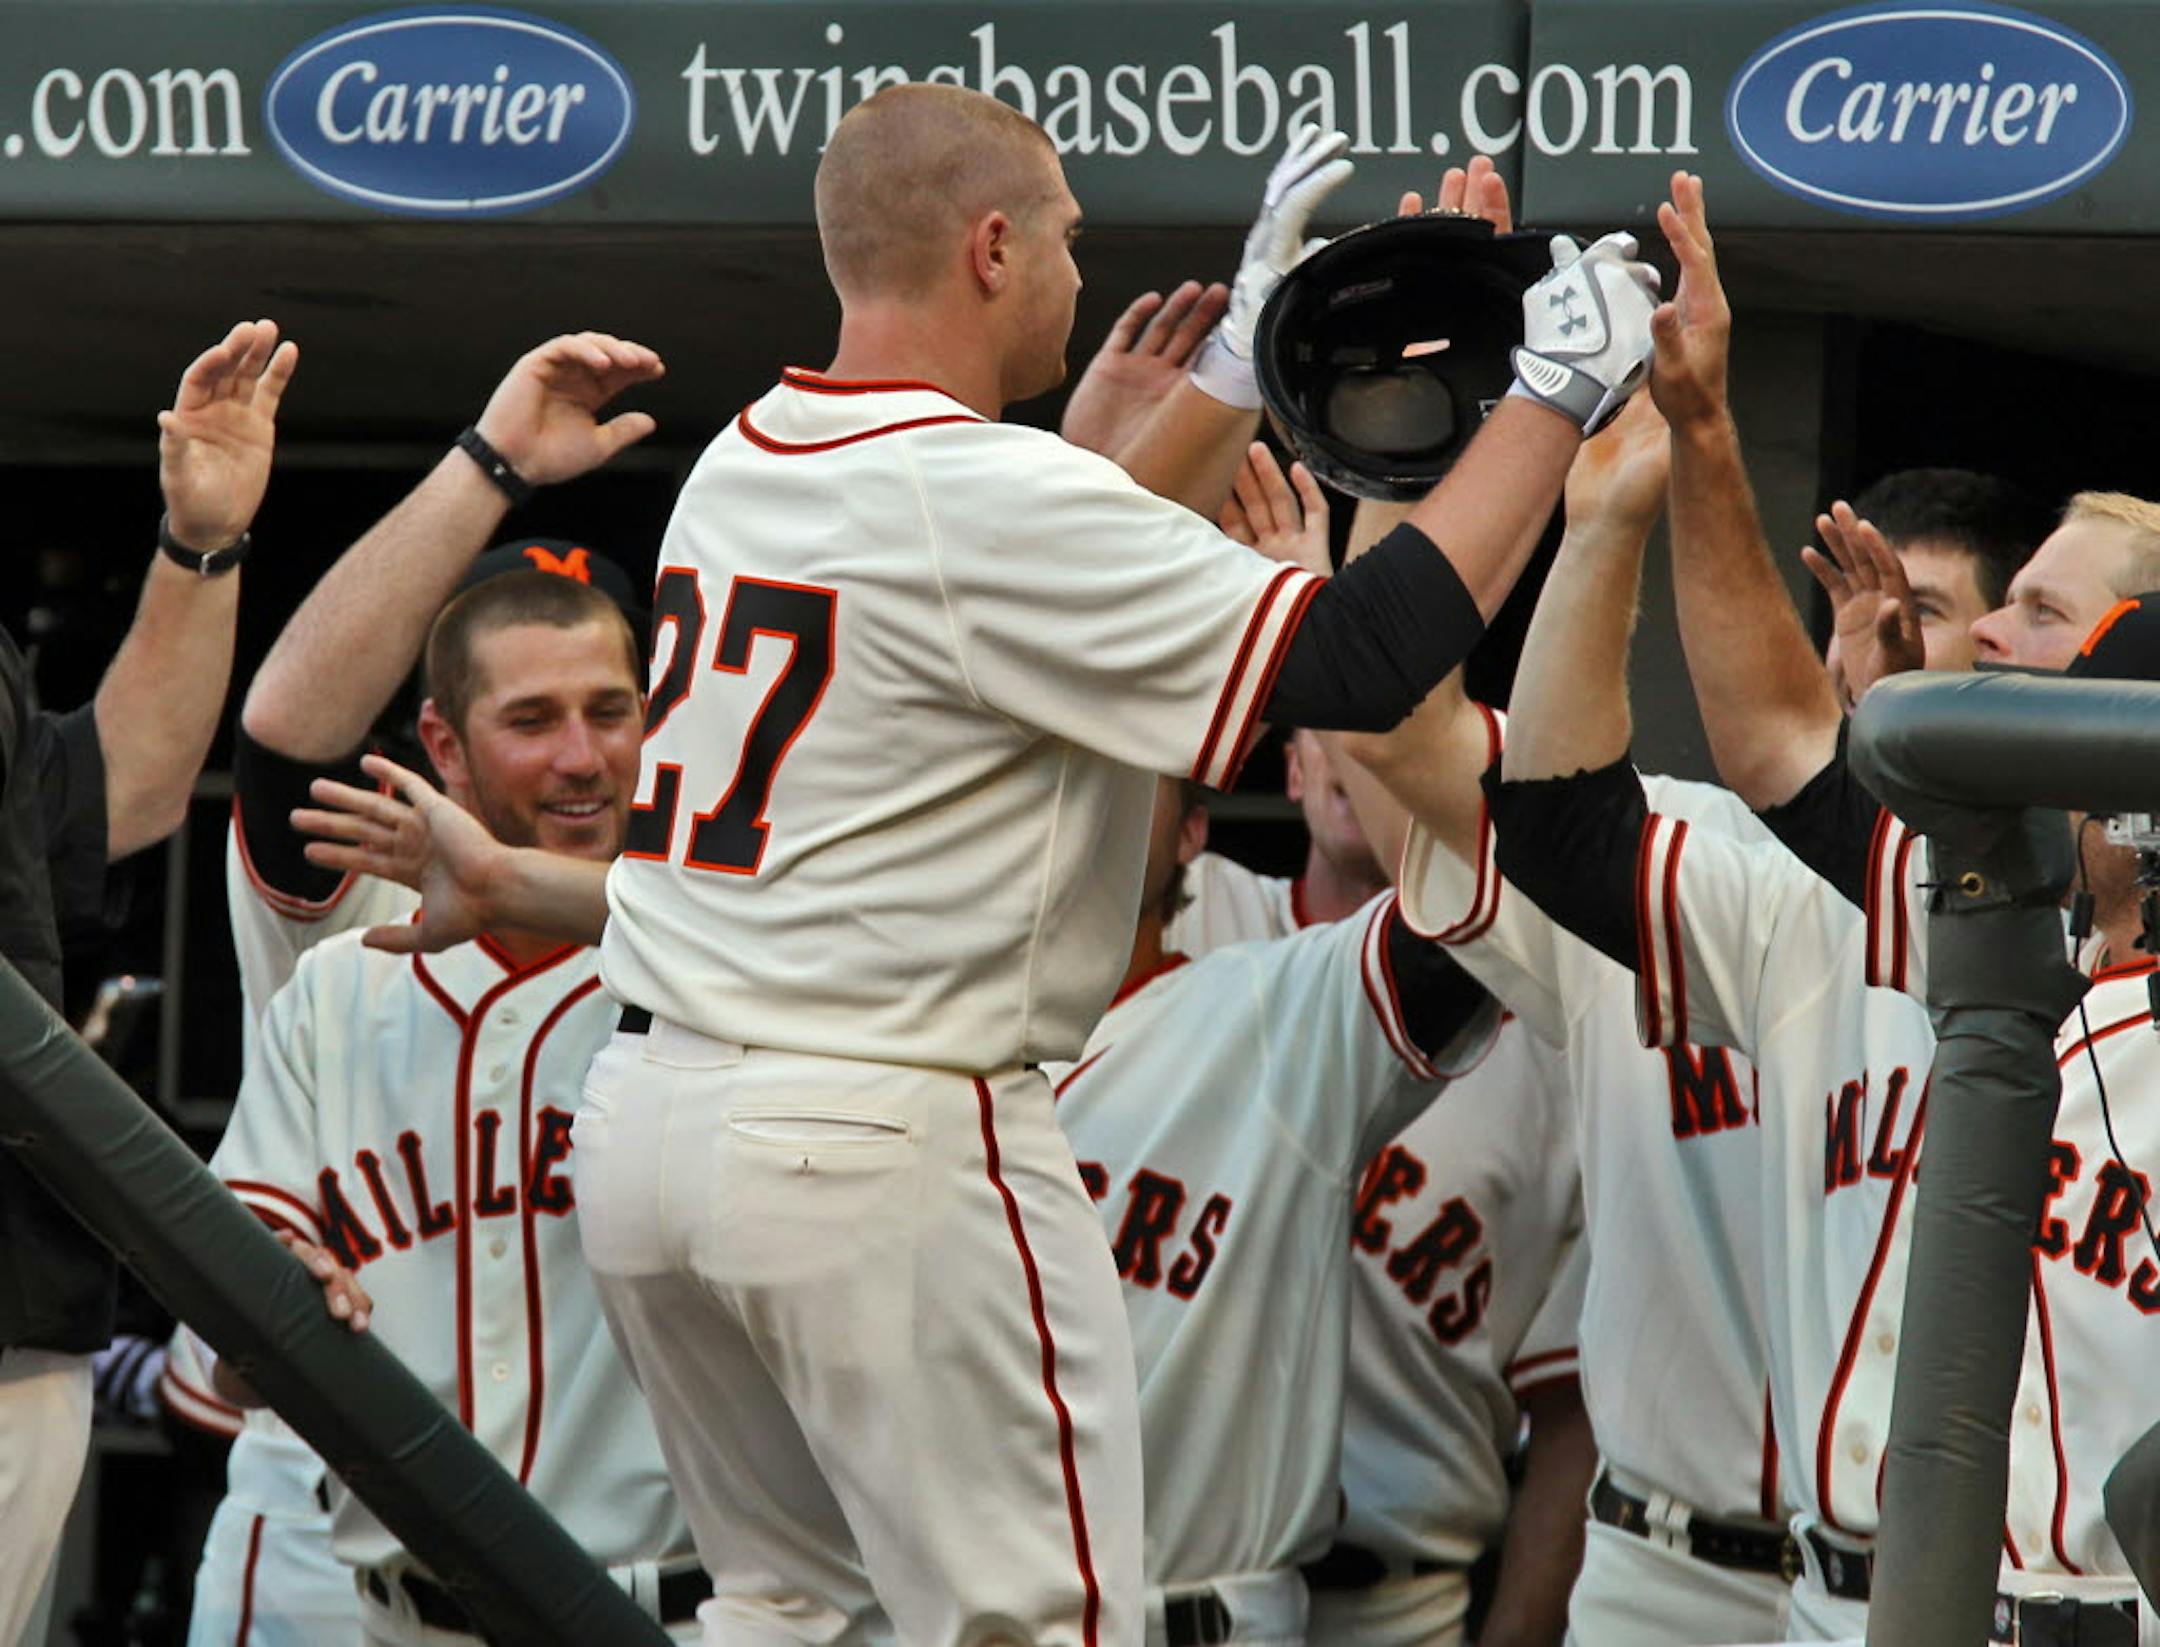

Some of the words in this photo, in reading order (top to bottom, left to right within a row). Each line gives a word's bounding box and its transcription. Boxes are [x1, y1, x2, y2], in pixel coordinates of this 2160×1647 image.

[4, 68, 251, 159] .com
[316, 61, 586, 145] Carrier
[681, 21, 1700, 157] twibaseball.com
[1785, 57, 2077, 146] Carrier
[622, 566, 838, 876] 27
[1350, 1143, 1492, 1347] ERS
